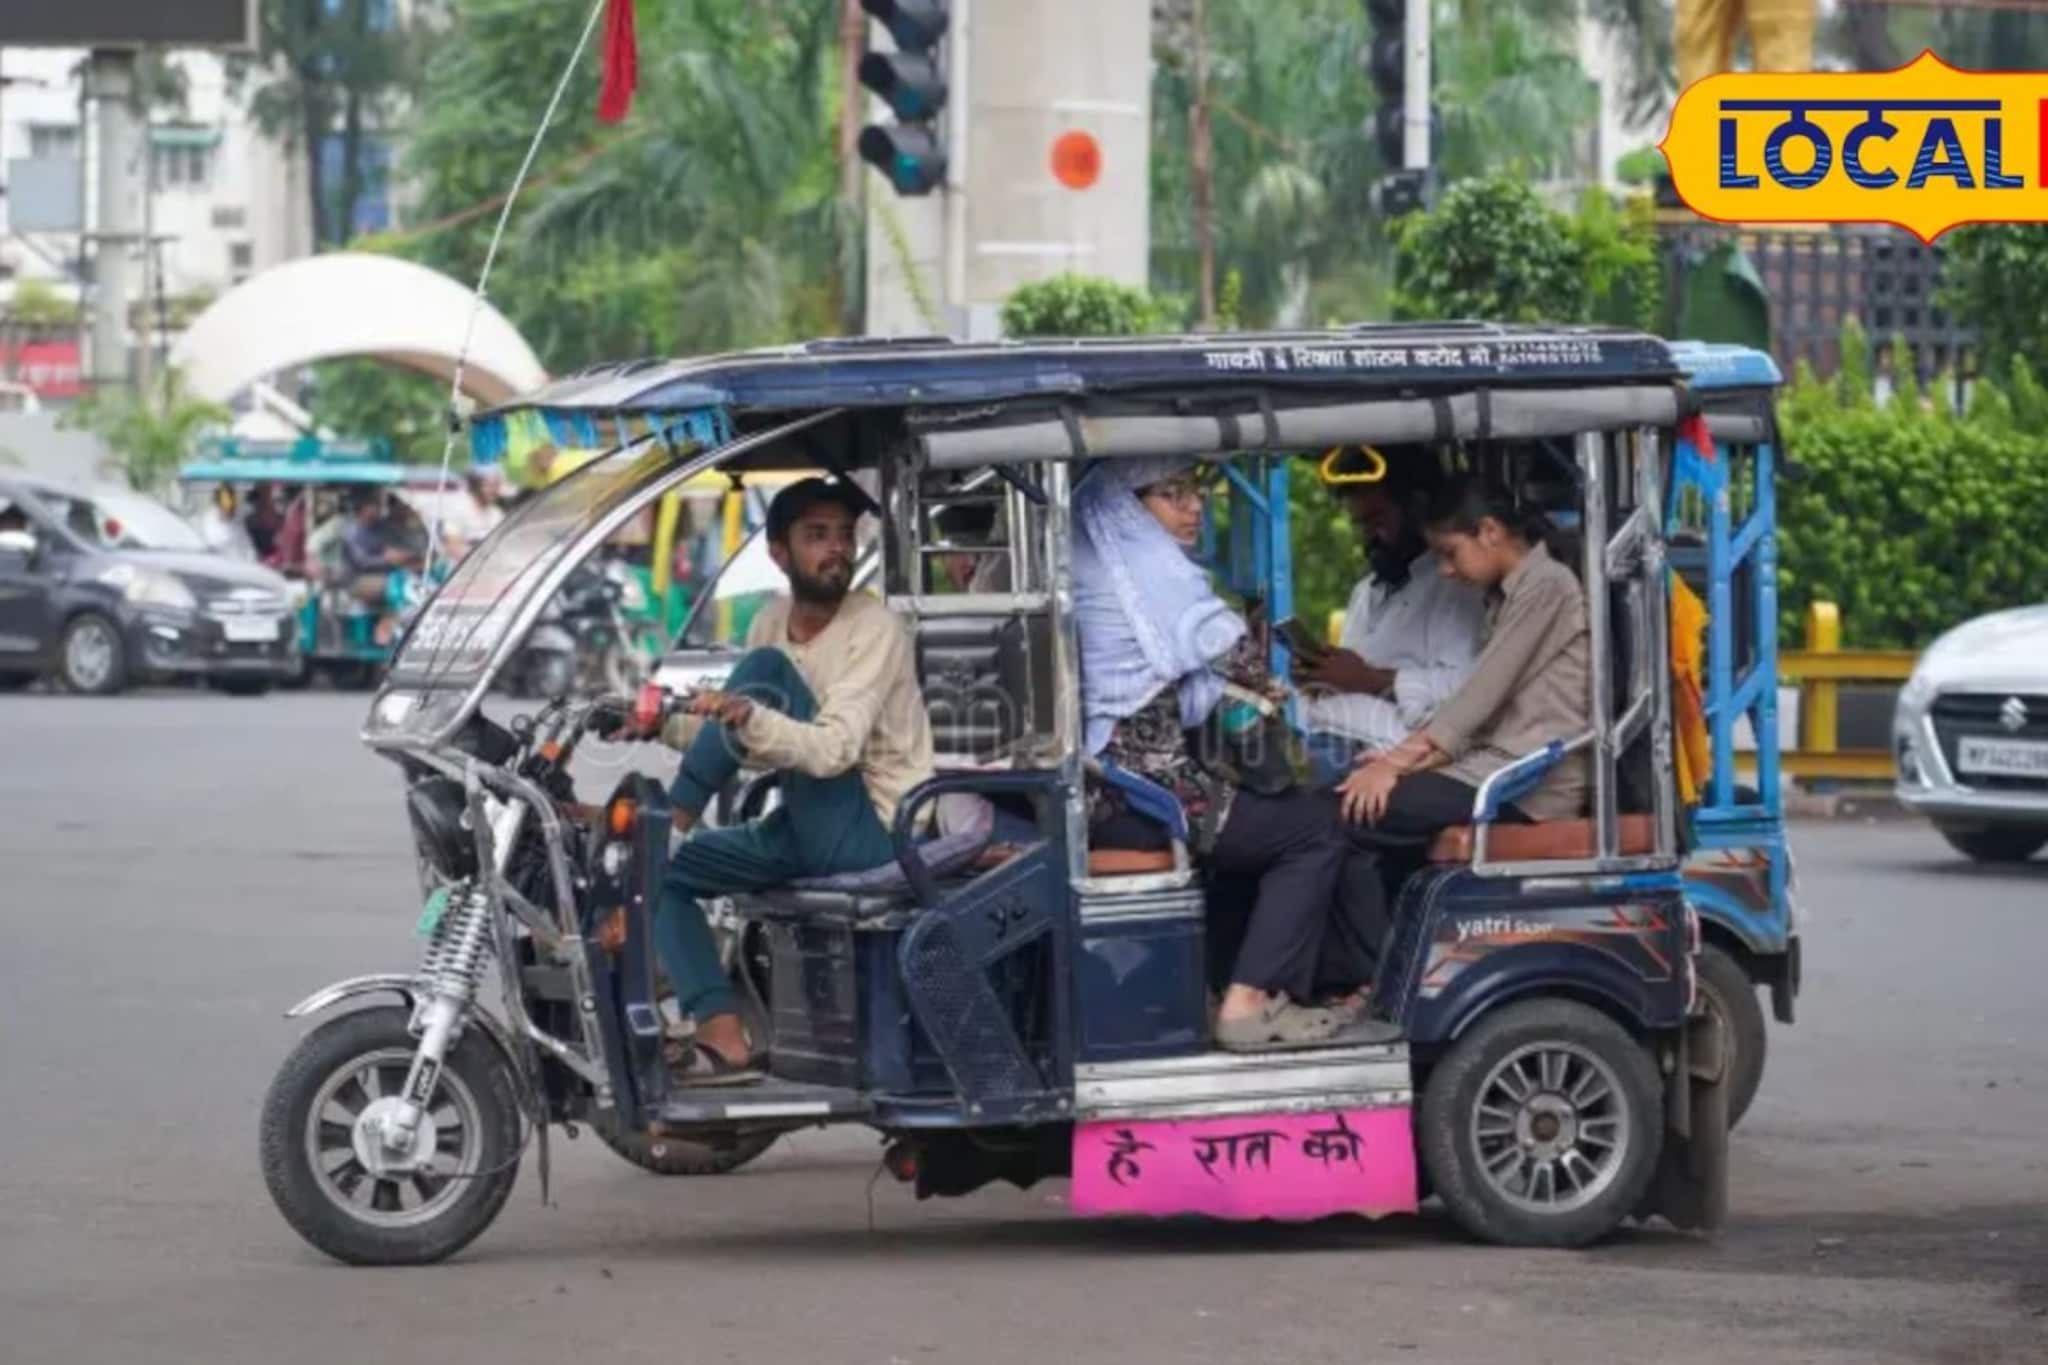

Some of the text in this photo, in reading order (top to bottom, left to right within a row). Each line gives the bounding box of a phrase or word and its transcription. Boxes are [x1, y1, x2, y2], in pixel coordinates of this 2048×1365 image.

[1456, 914, 1511, 942] yatri
[1191, 1130, 1291, 1182] रात
[1303, 1114, 1364, 1173] को
